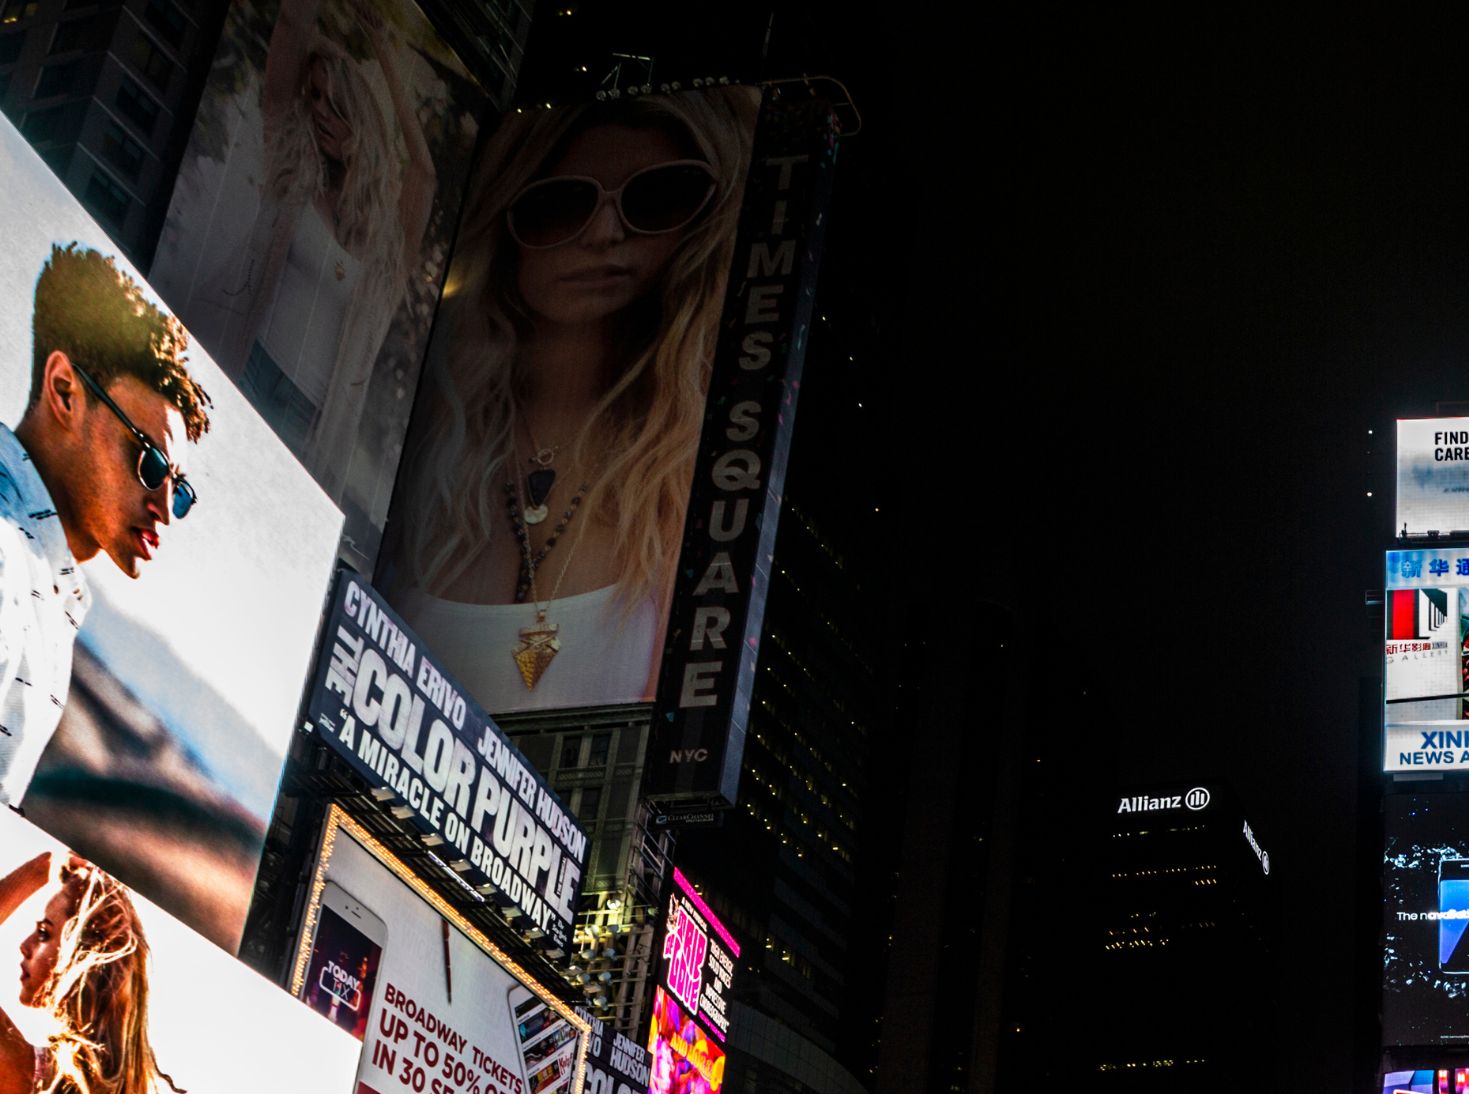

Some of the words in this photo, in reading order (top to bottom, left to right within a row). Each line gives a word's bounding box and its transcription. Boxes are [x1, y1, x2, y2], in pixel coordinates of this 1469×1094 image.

[739, 154, 809, 371] TIMES
[1435, 431, 1469, 446] FIND
[679, 400, 761, 707] SQUARE
[344, 581, 416, 678] CYNTHIA
[416, 659, 467, 731] ERIVO
[325, 625, 363, 707] THE
[353, 649, 476, 822] COLOR
[471, 766, 581, 925] PURPLE
[669, 747, 708, 764] NYC
[1400, 750, 1454, 767] NEWS
[358, 733, 441, 827] MIRACLE
[444, 815, 469, 854] ON
[476, 726, 537, 808] JENNIFER
[535, 791, 588, 863] HUDSON
[1117, 796, 1182, 813] Allianz
[1397, 911, 1418, 921] The
[327, 960, 360, 989] TODAY
[332, 977, 351, 1000] TIX
[379, 1012, 408, 1044] UP
[413, 1029, 439, 1066] TO
[386, 982, 466, 1054] BROADWAY
[472, 1045, 522, 1094] TICKETS
[613, 1032, 645, 1063] JENNIFER
[372, 1041, 393, 1074] IN
[400, 1062, 424, 1093] 30
[610, 1047, 651, 1087] HUDSON
